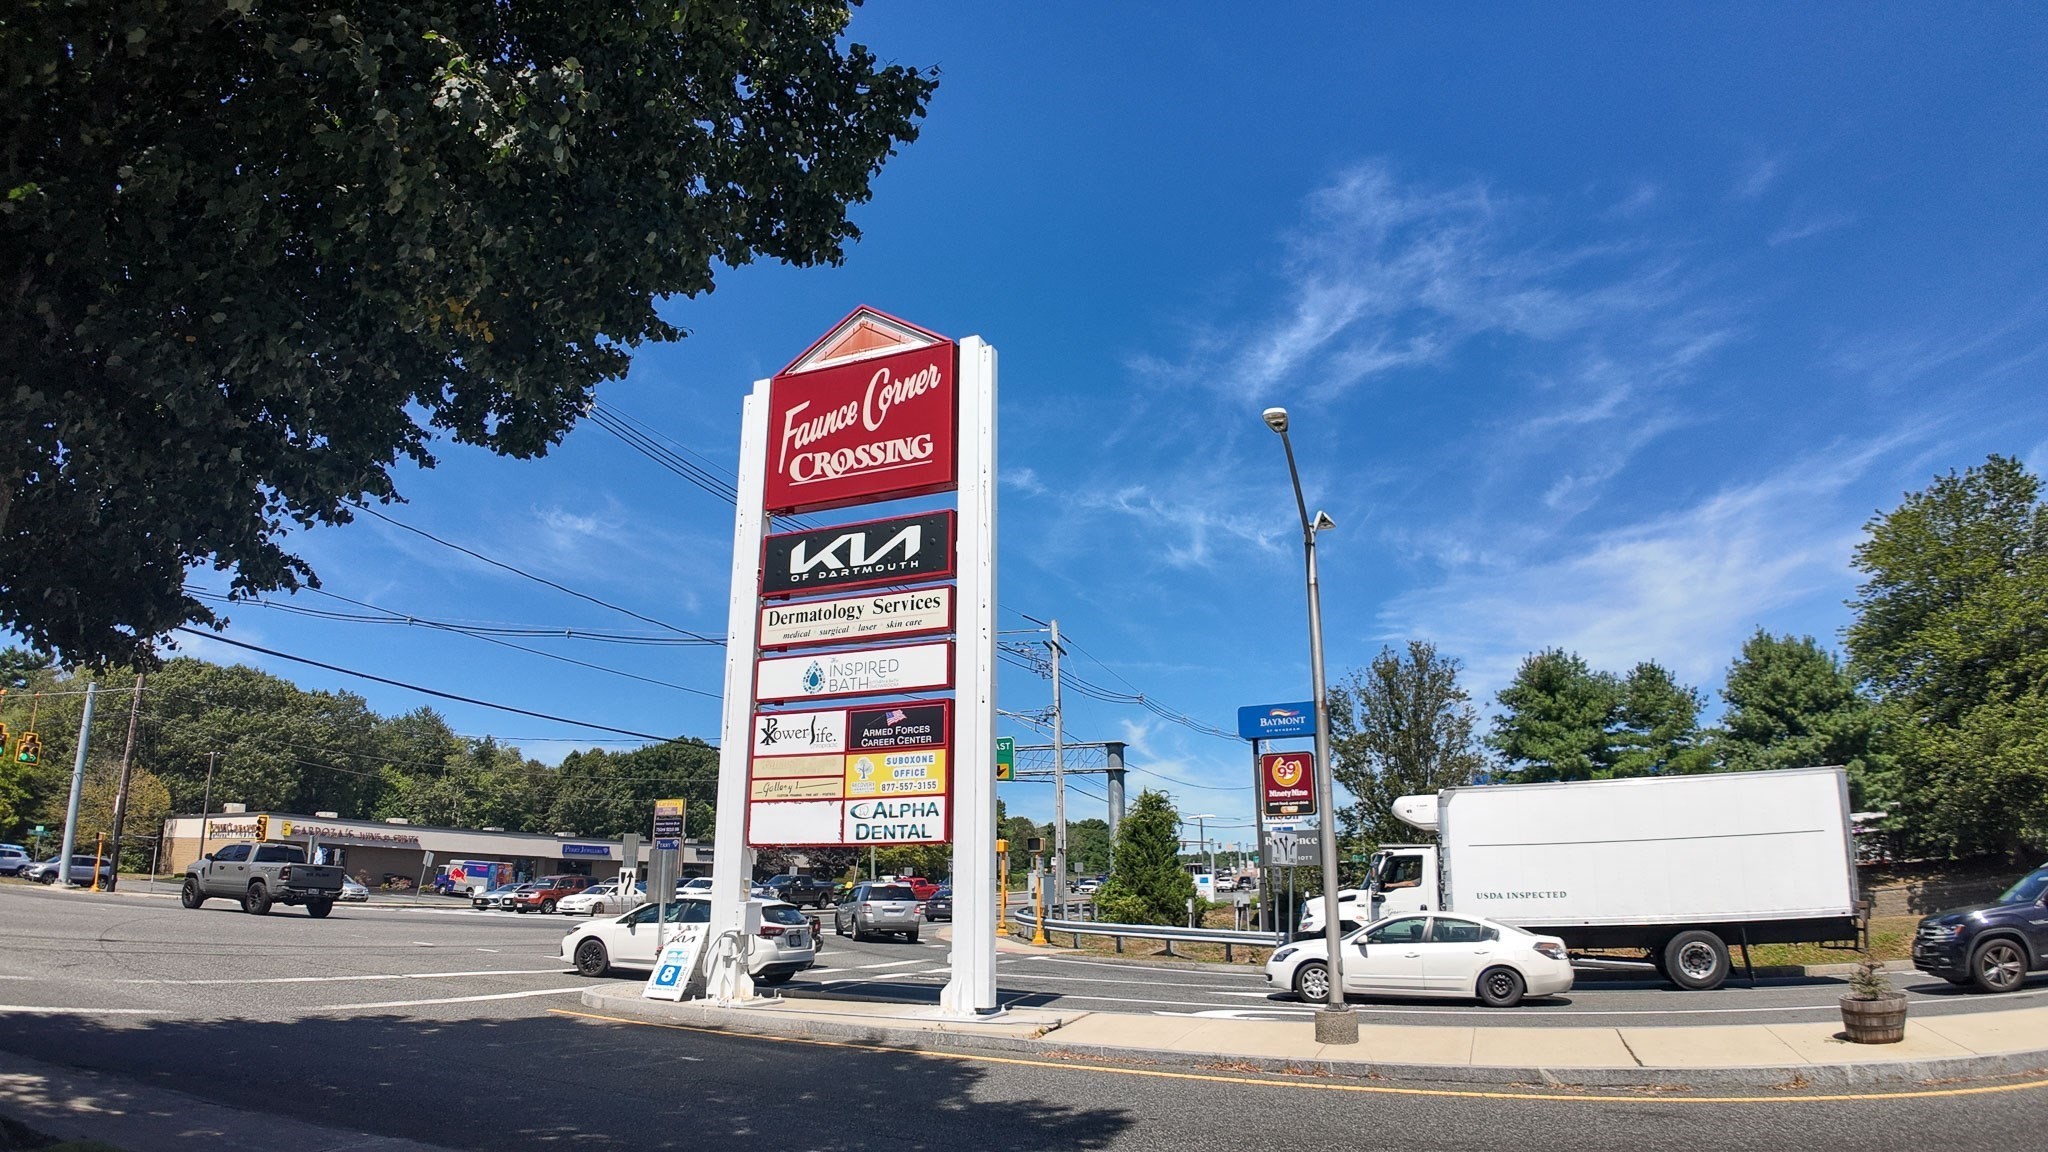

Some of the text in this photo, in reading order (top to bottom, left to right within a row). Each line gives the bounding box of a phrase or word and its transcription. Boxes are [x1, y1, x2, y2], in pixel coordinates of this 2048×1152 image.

[778, 363, 942, 474] Faunce Corner
[789, 433, 934, 482] CROSSING
[789, 525, 922, 574] KIA
[790, 560, 919, 582] OF DARTMOUTH
[768, 594, 941, 627] Dermatology Services
[782, 618, 923, 640] medical surgical laser skin care
[829, 658, 899, 678] INSPIRED
[829, 676, 869, 692] BATH
[1260, 716, 1306, 727] BAYMONT
[863, 725, 931, 737] ARMED FORCES
[861, 735, 932, 747] CAREER CENTER
[886, 755, 934, 765] SUBOXONE
[894, 768, 925, 778] OFFICE
[881, 781, 937, 792] 877-557-3155
[1268, 789, 1291, 798] Ninety
[872, 801, 940, 819] ALPHA
[855, 823, 932, 841] DENTAL
[1476, 891, 1567, 900] USDA INSPECTED
[660, 966, 676, 982] 8
